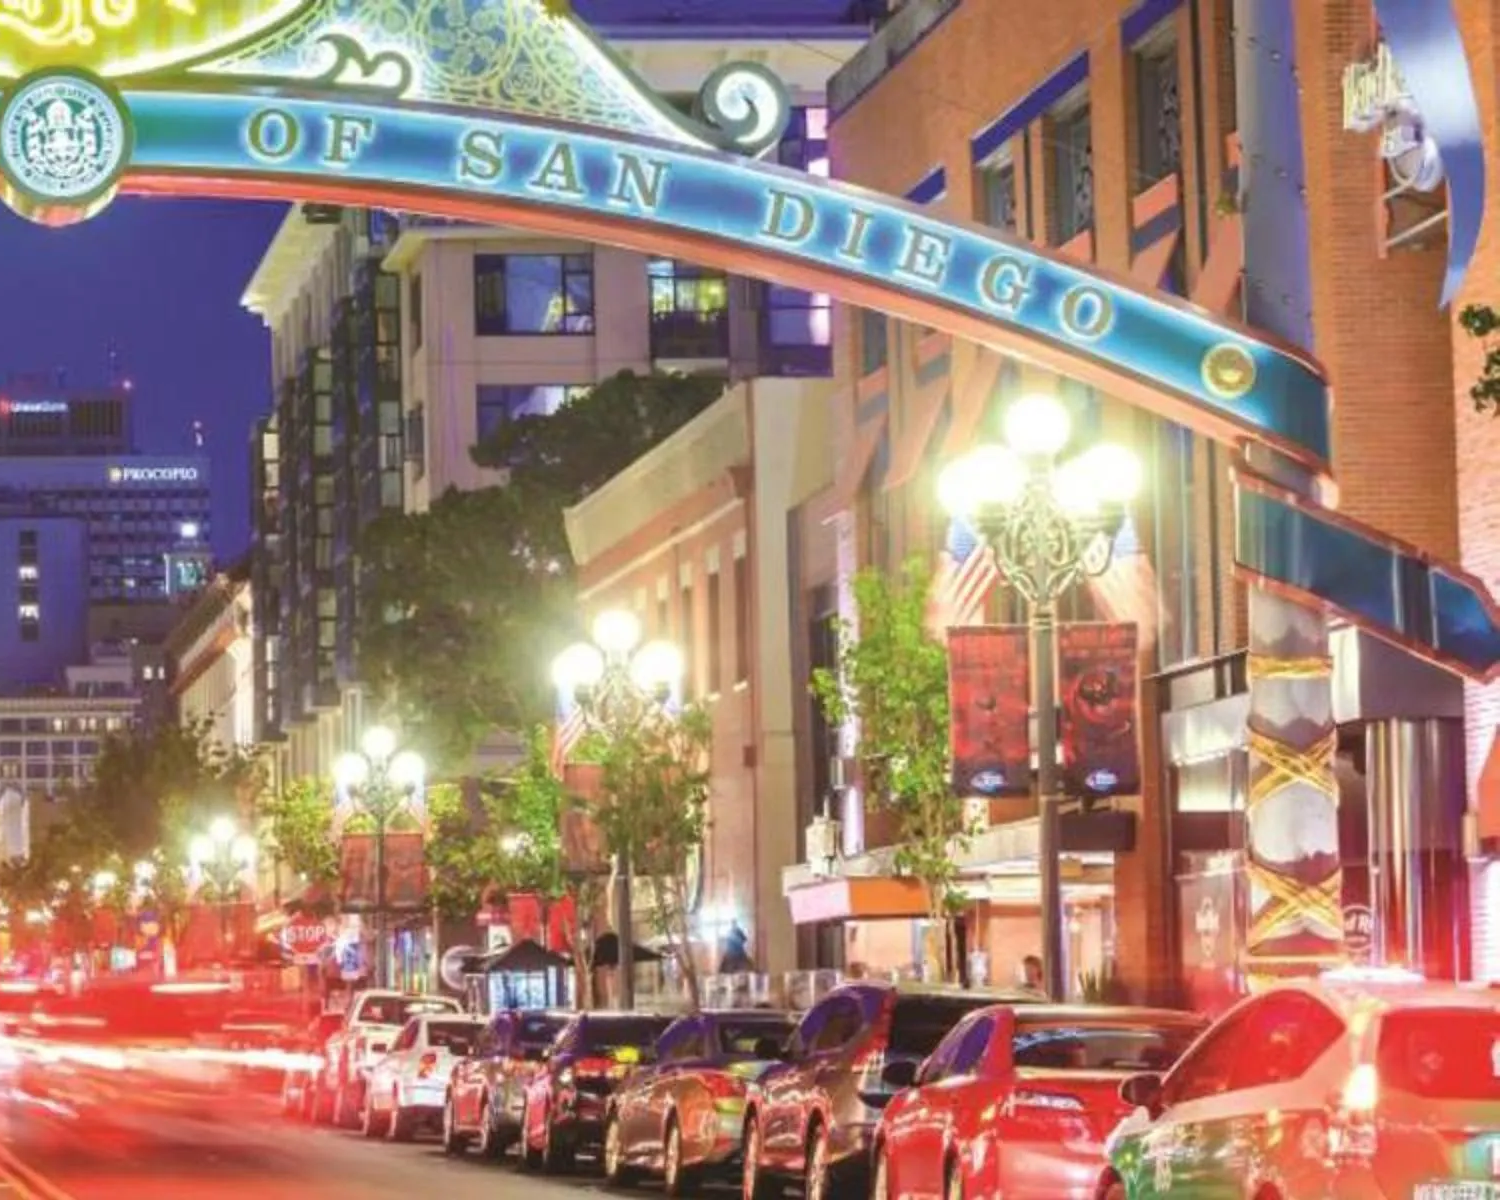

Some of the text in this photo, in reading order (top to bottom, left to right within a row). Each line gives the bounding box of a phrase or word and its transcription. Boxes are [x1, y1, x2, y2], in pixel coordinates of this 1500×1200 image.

[247, 108, 373, 164] OF
[460, 129, 670, 208] SAN
[760, 187, 1113, 339] DIEGO
[122, 467, 198, 481] PROCOPIO
[286, 925, 325, 943] STOP
